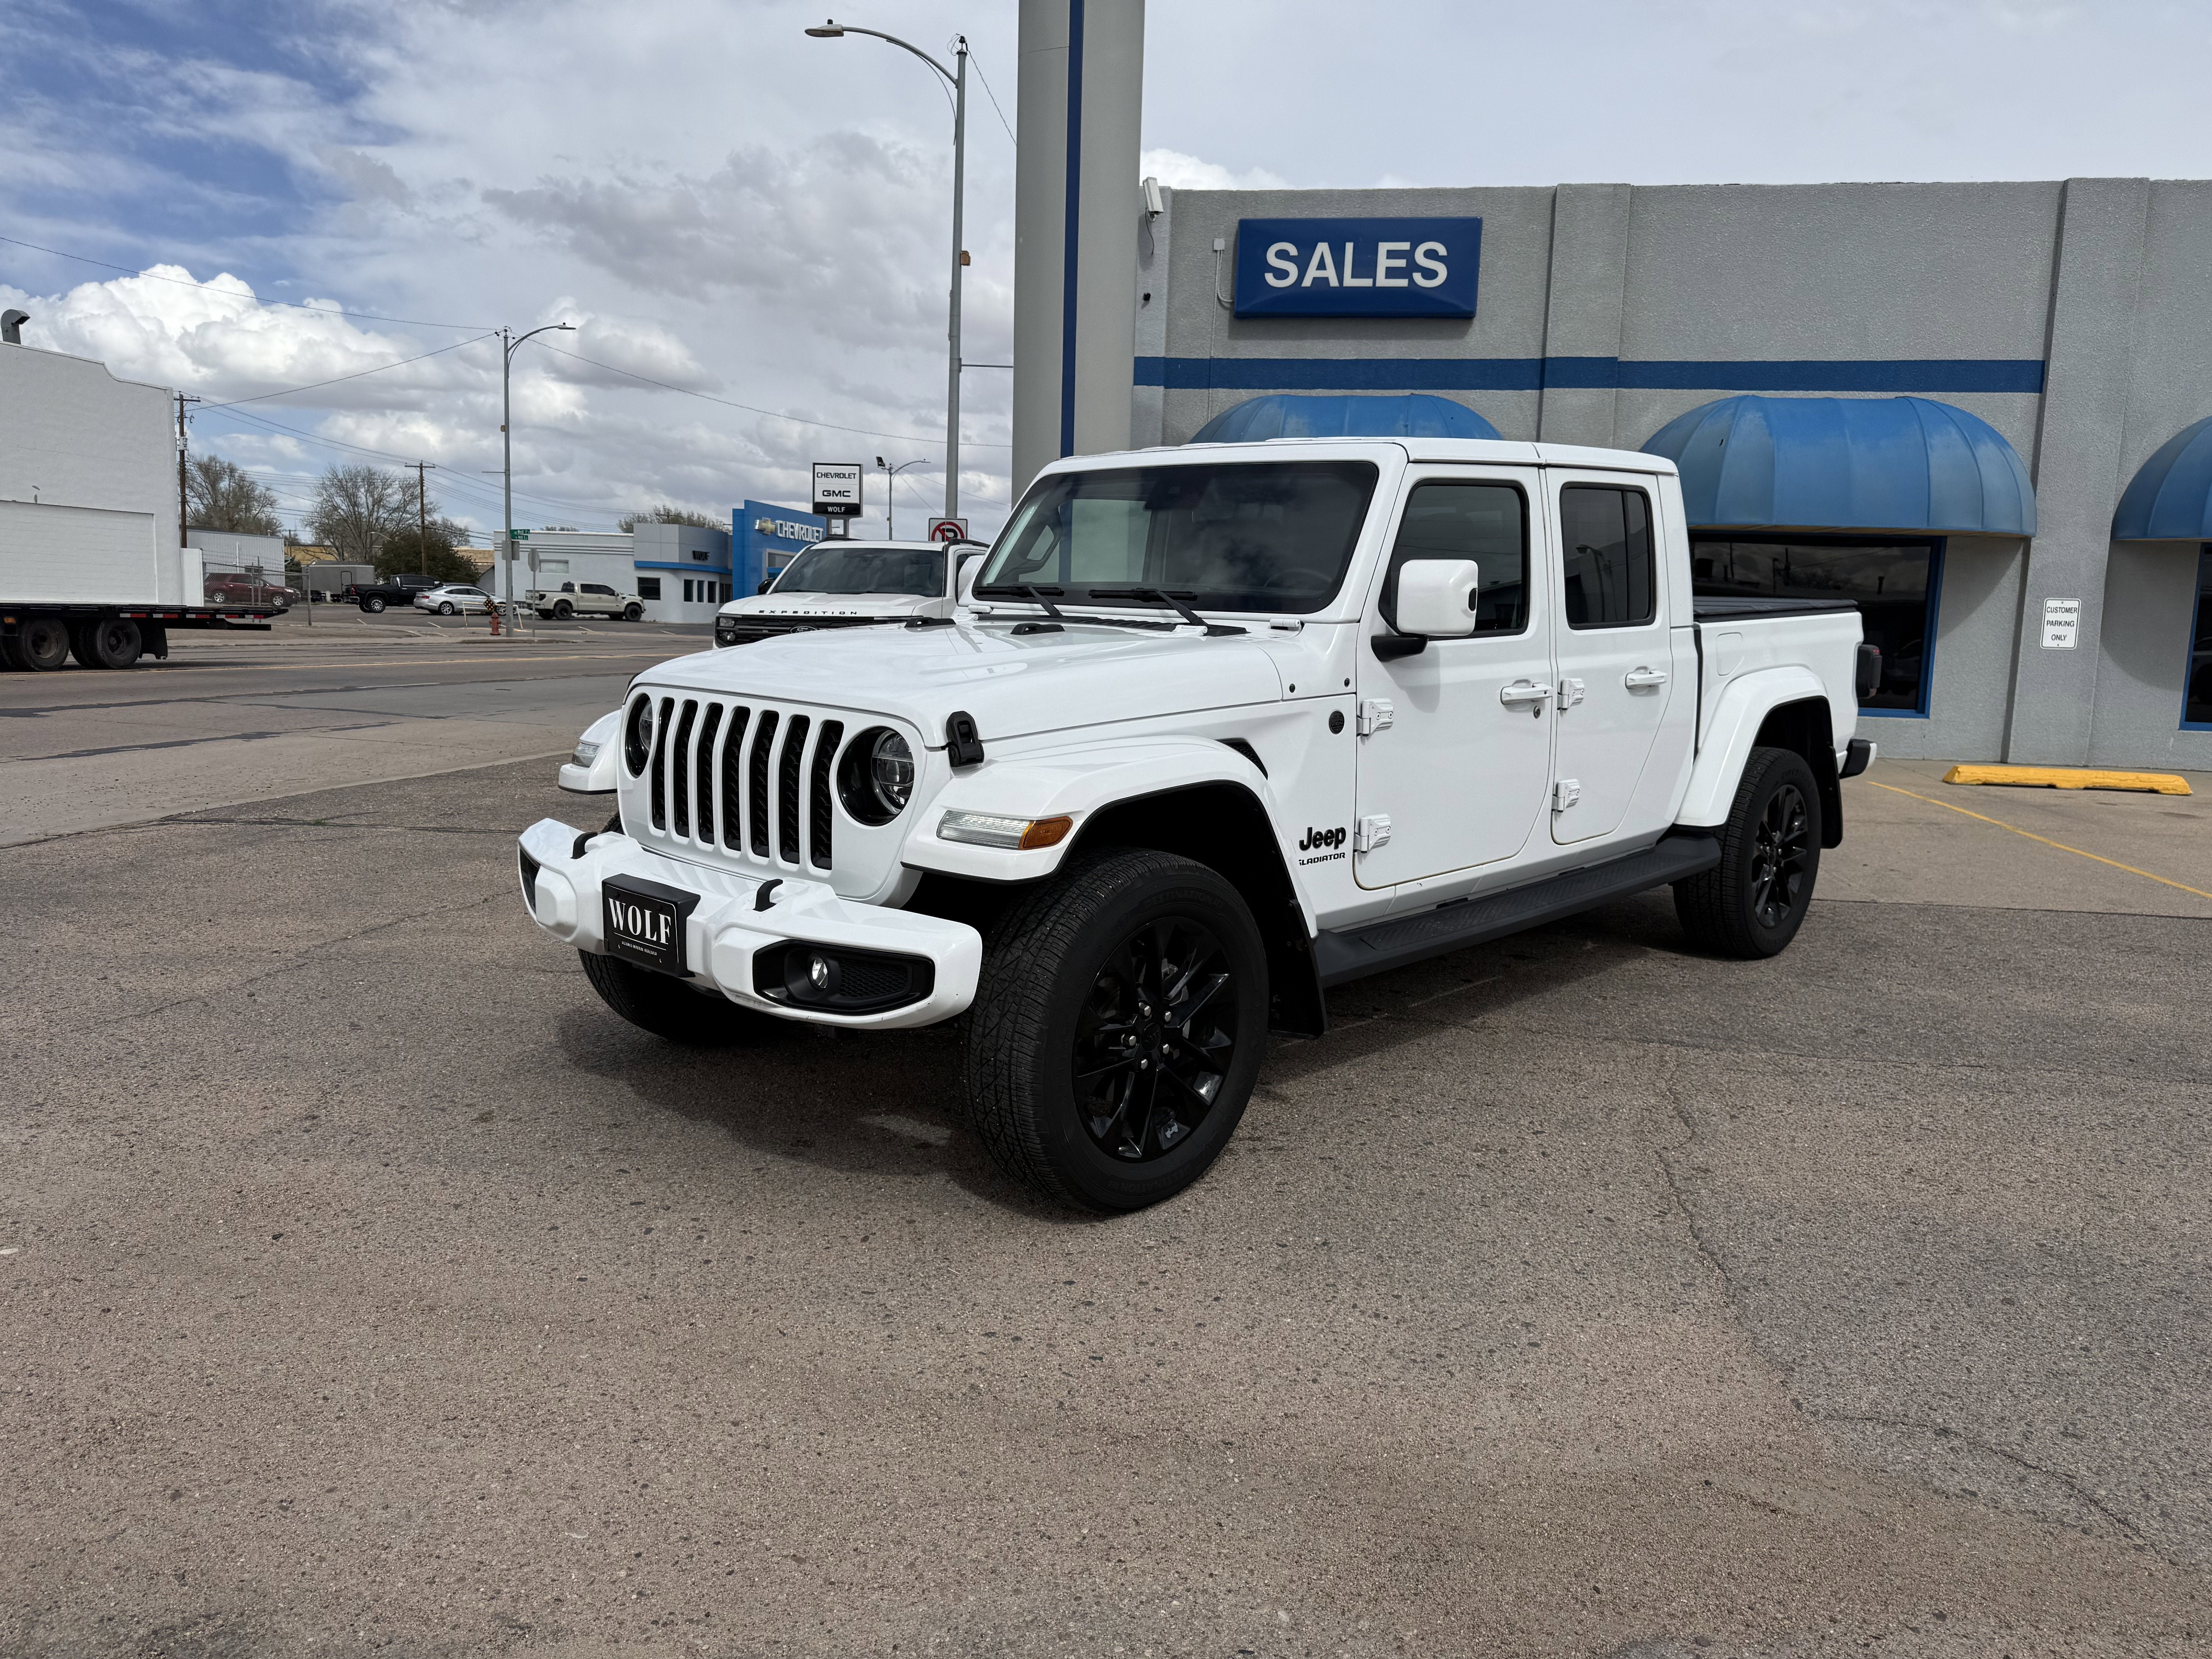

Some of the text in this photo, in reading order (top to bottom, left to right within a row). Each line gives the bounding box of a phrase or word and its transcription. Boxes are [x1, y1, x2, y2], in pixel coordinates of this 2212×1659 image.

[1264, 241, 1448, 289] SALES
[776, 520, 823, 543] CHEVROLET
[1299, 827, 1346, 851] Jeep
[608, 898, 672, 945] WOLF
